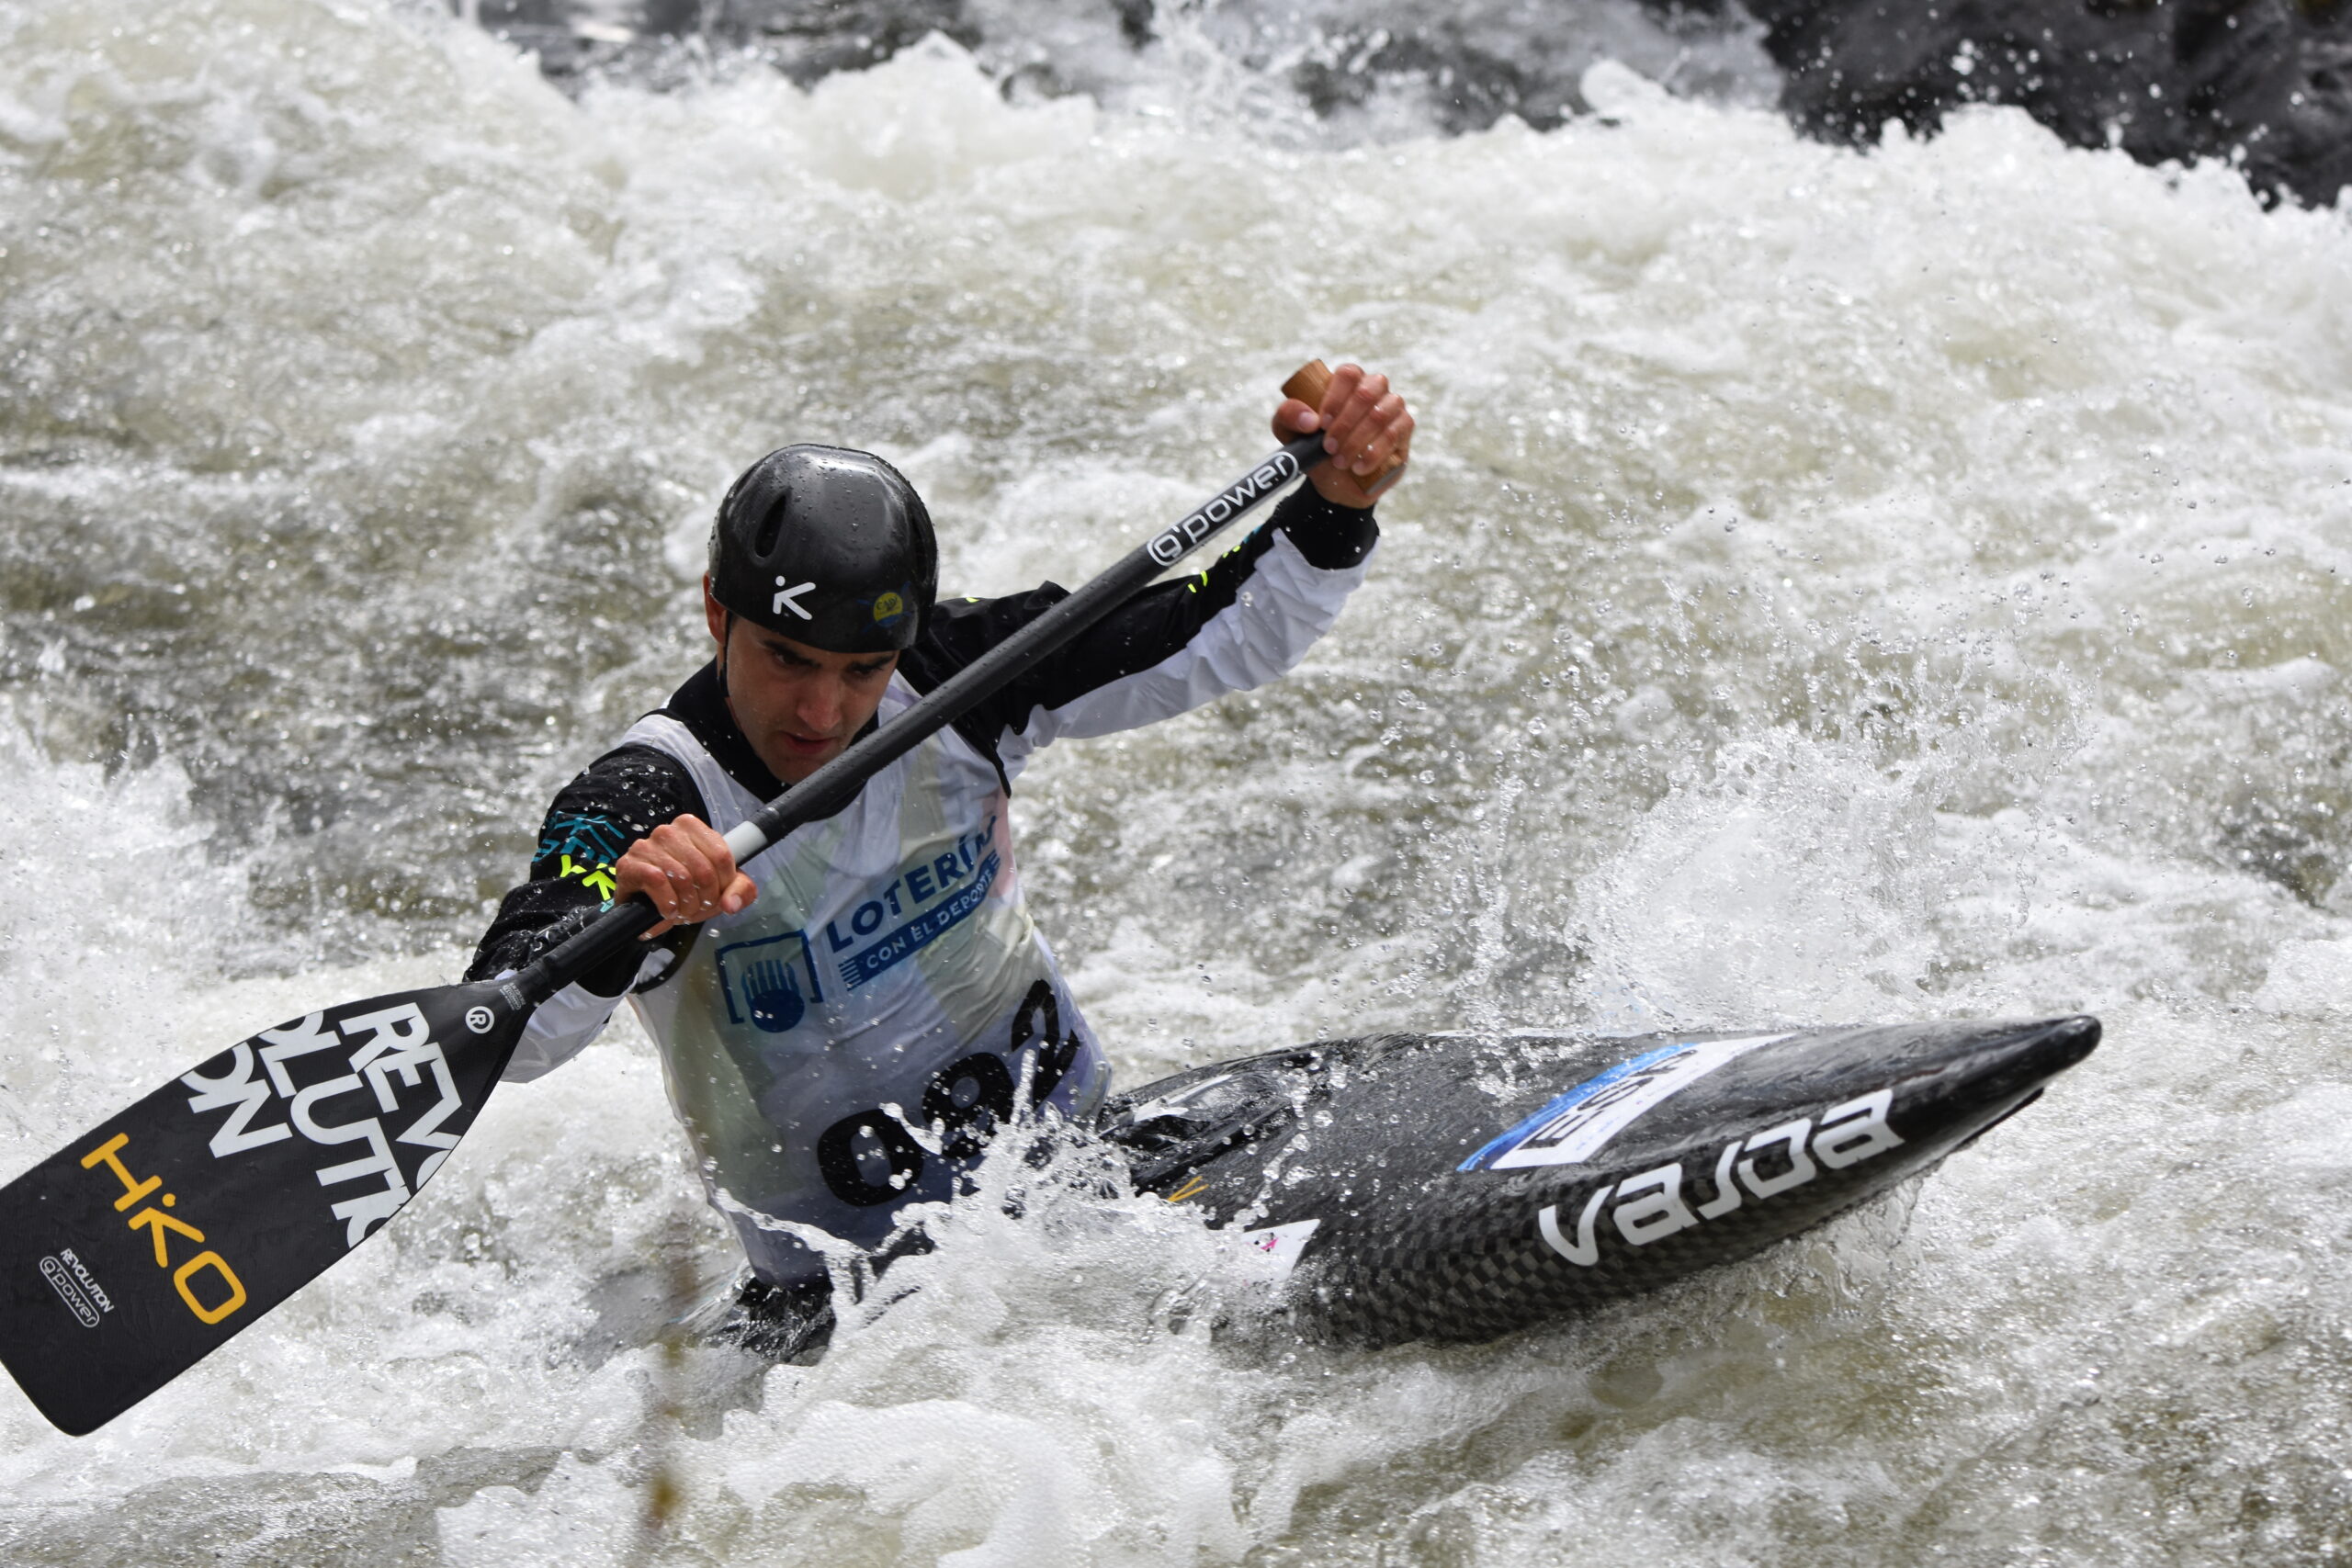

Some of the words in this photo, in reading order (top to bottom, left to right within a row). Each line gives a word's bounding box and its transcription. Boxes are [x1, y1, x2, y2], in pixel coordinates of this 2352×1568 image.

[866, 937, 906, 969] CON
[911, 921, 933, 942] EL
[937, 870, 992, 925] DEPORTE
[817, 979, 1080, 1207] 092
[60, 1247, 115, 1314] REVOLUTION
